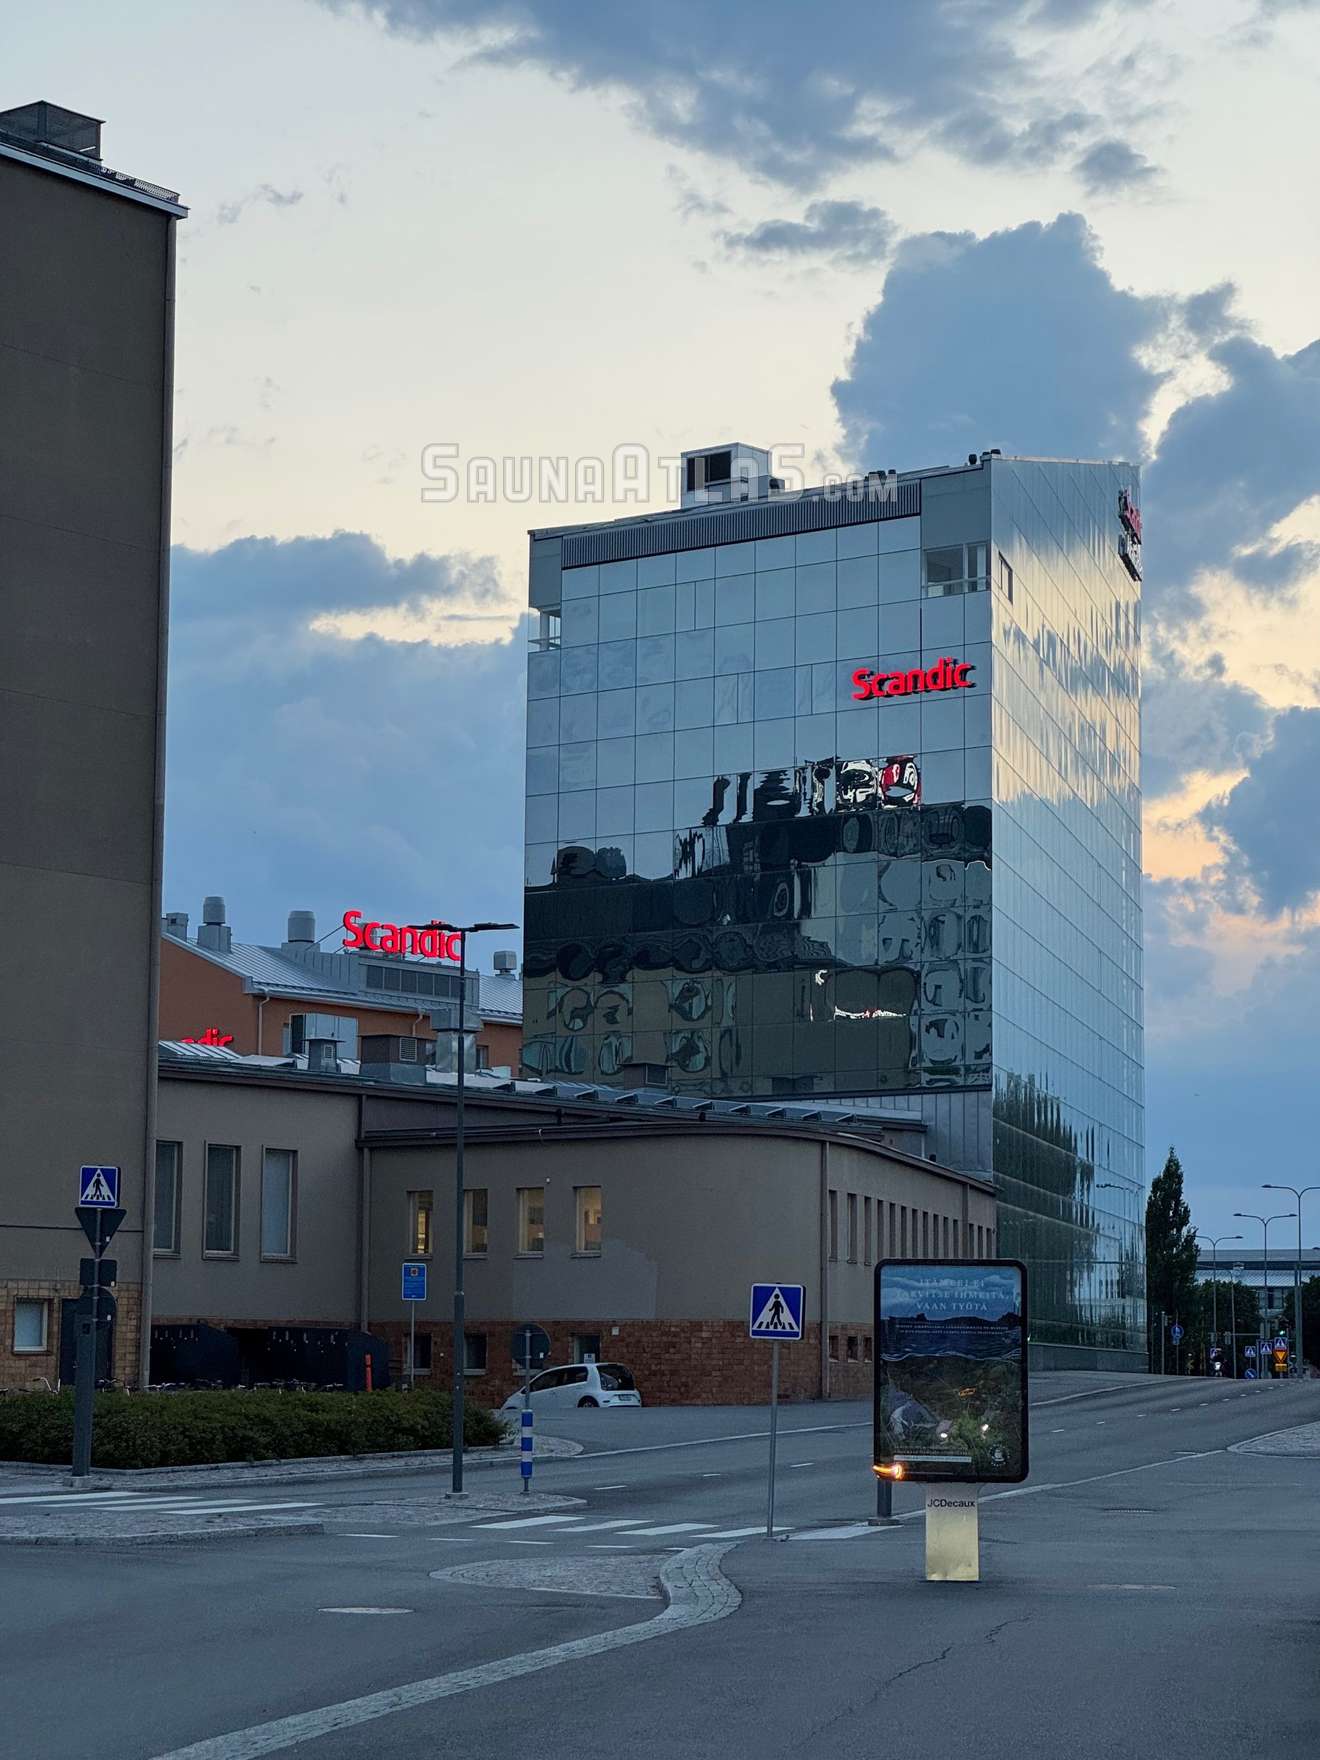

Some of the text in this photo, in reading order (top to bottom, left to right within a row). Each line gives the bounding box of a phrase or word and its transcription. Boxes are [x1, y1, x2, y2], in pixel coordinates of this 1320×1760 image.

[851, 656, 973, 699] Scandic
[341, 909, 461, 962] Scandic
[916, 1302, 946, 1311] VAAN
[927, 1498, 976, 1508] JCDecaux
